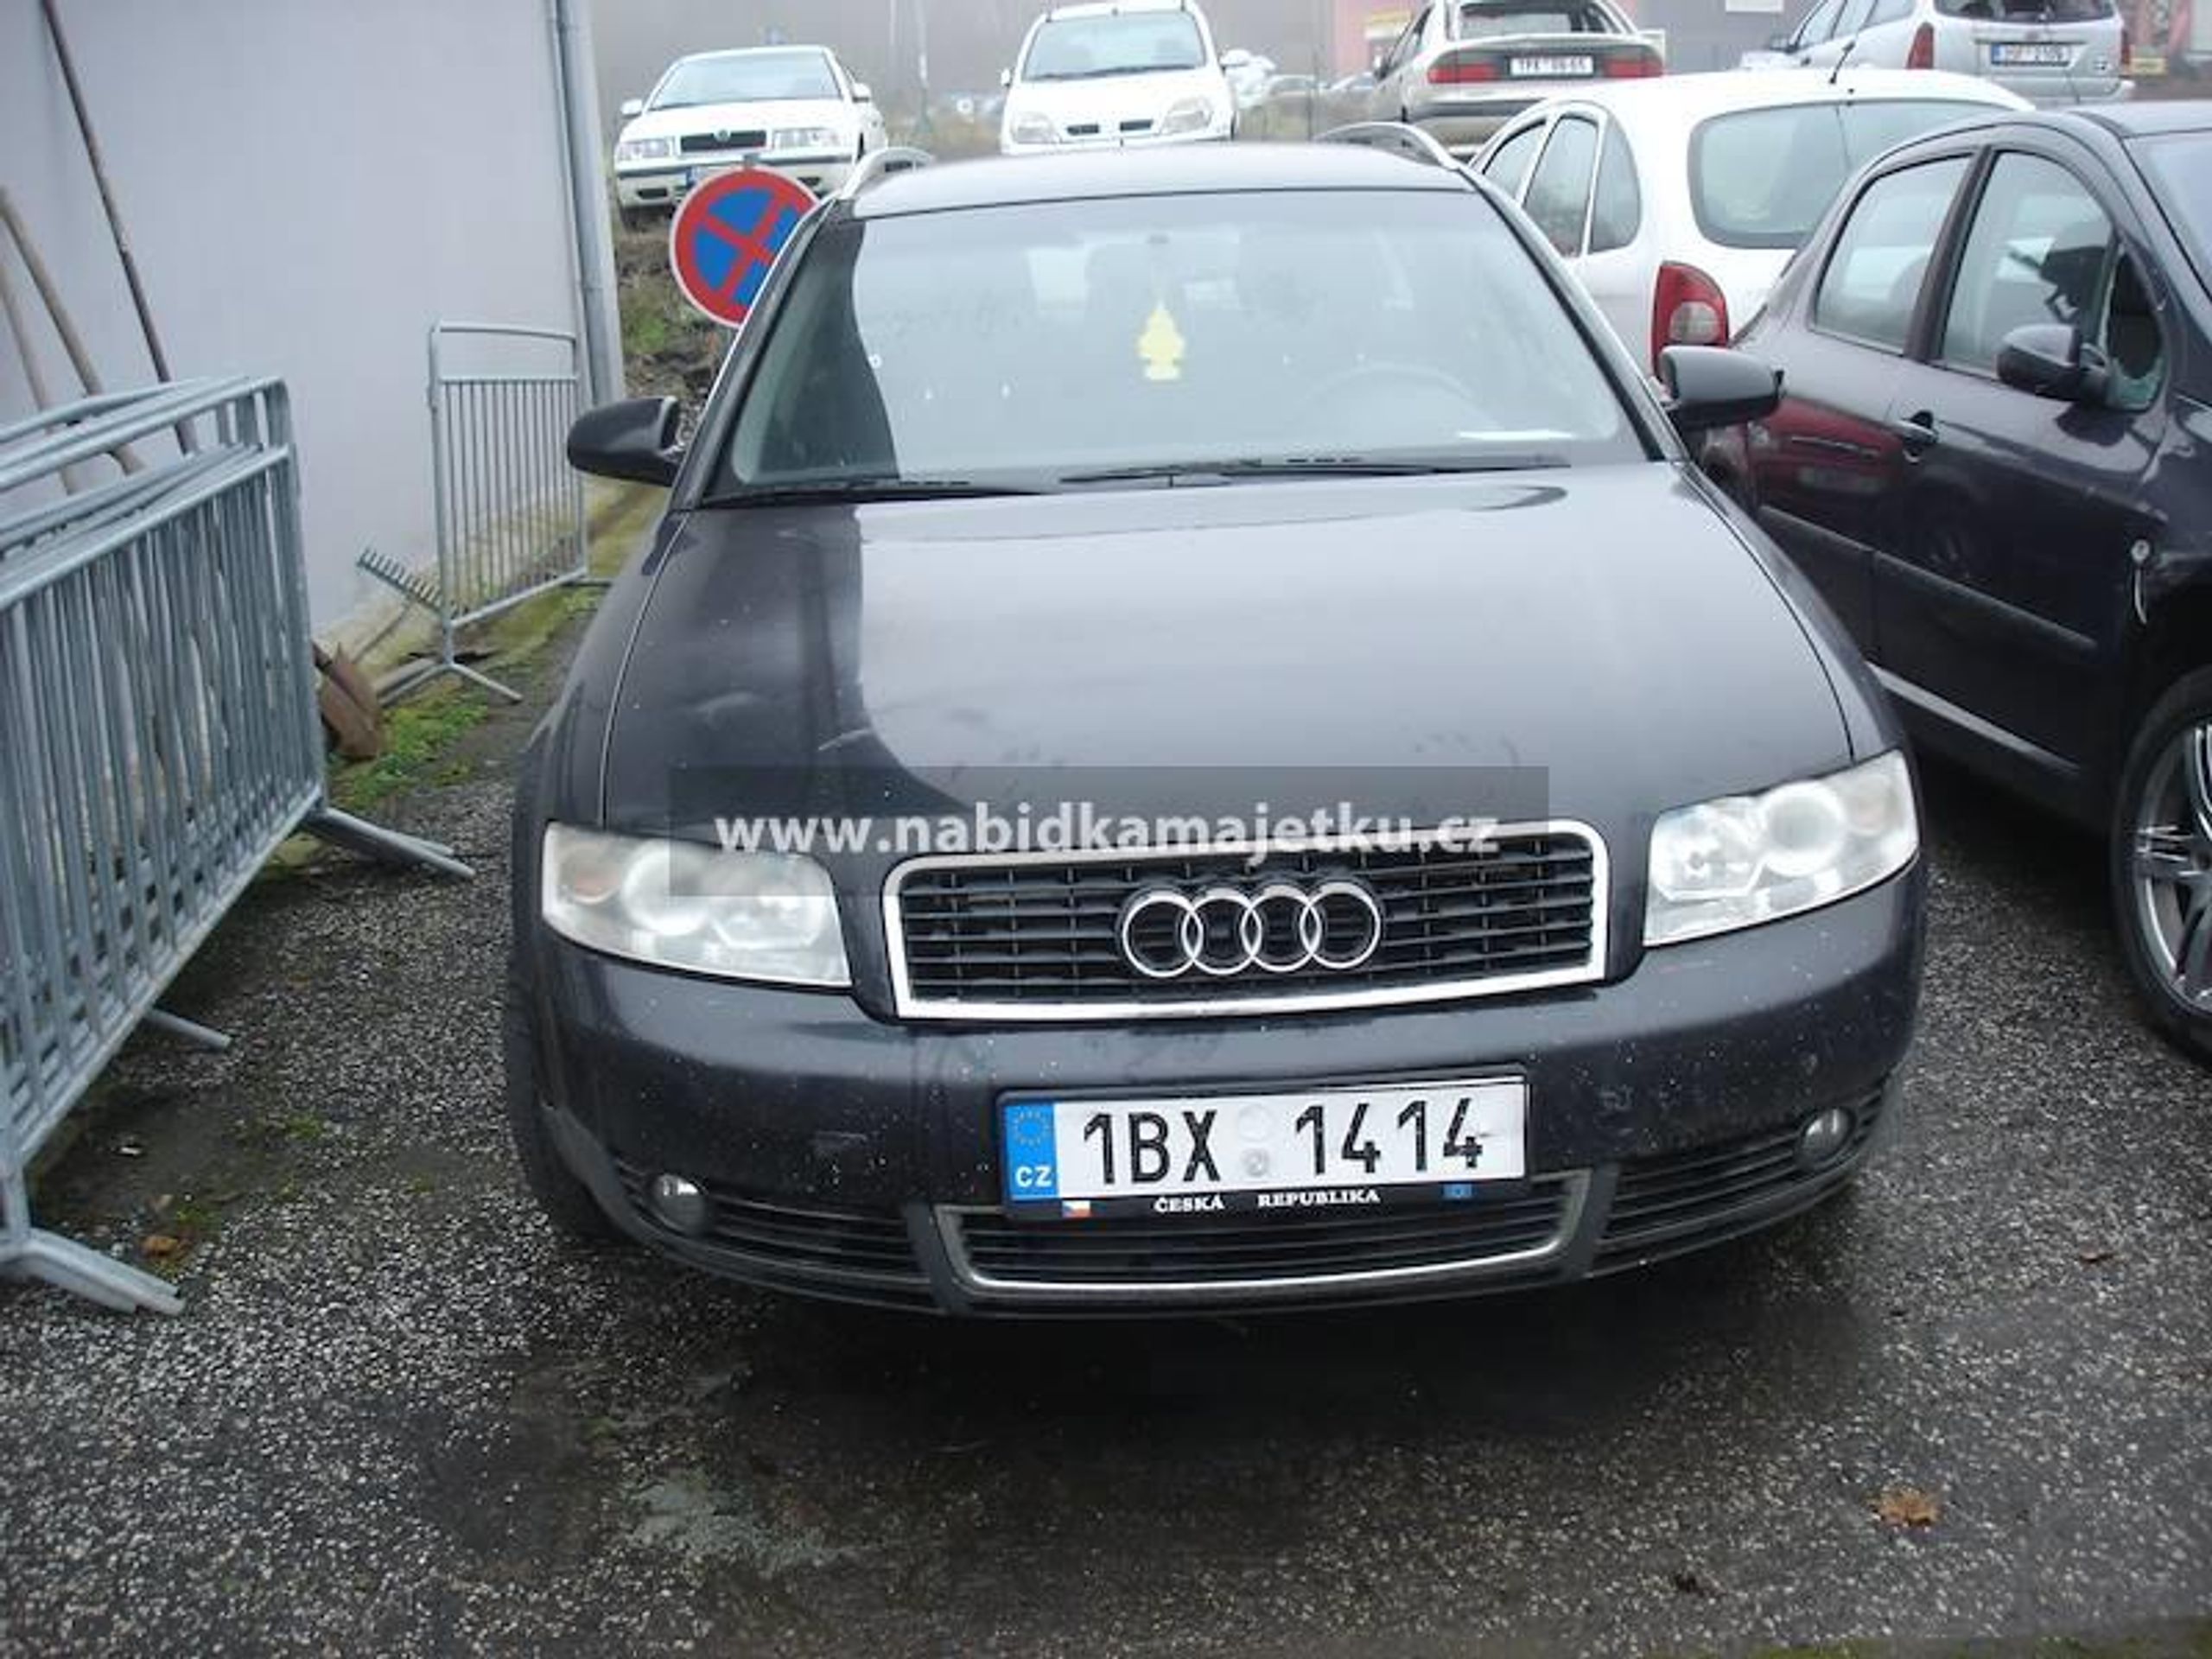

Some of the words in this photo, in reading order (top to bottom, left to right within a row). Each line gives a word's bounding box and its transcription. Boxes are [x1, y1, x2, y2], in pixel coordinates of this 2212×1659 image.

[1084, 1109, 1221, 1185] 1BX
[1296, 1096, 1483, 1177] 1414
[1017, 1167, 1053, 1188] CZ
[1257, 1189, 1381, 1207] REPUBLIKA
